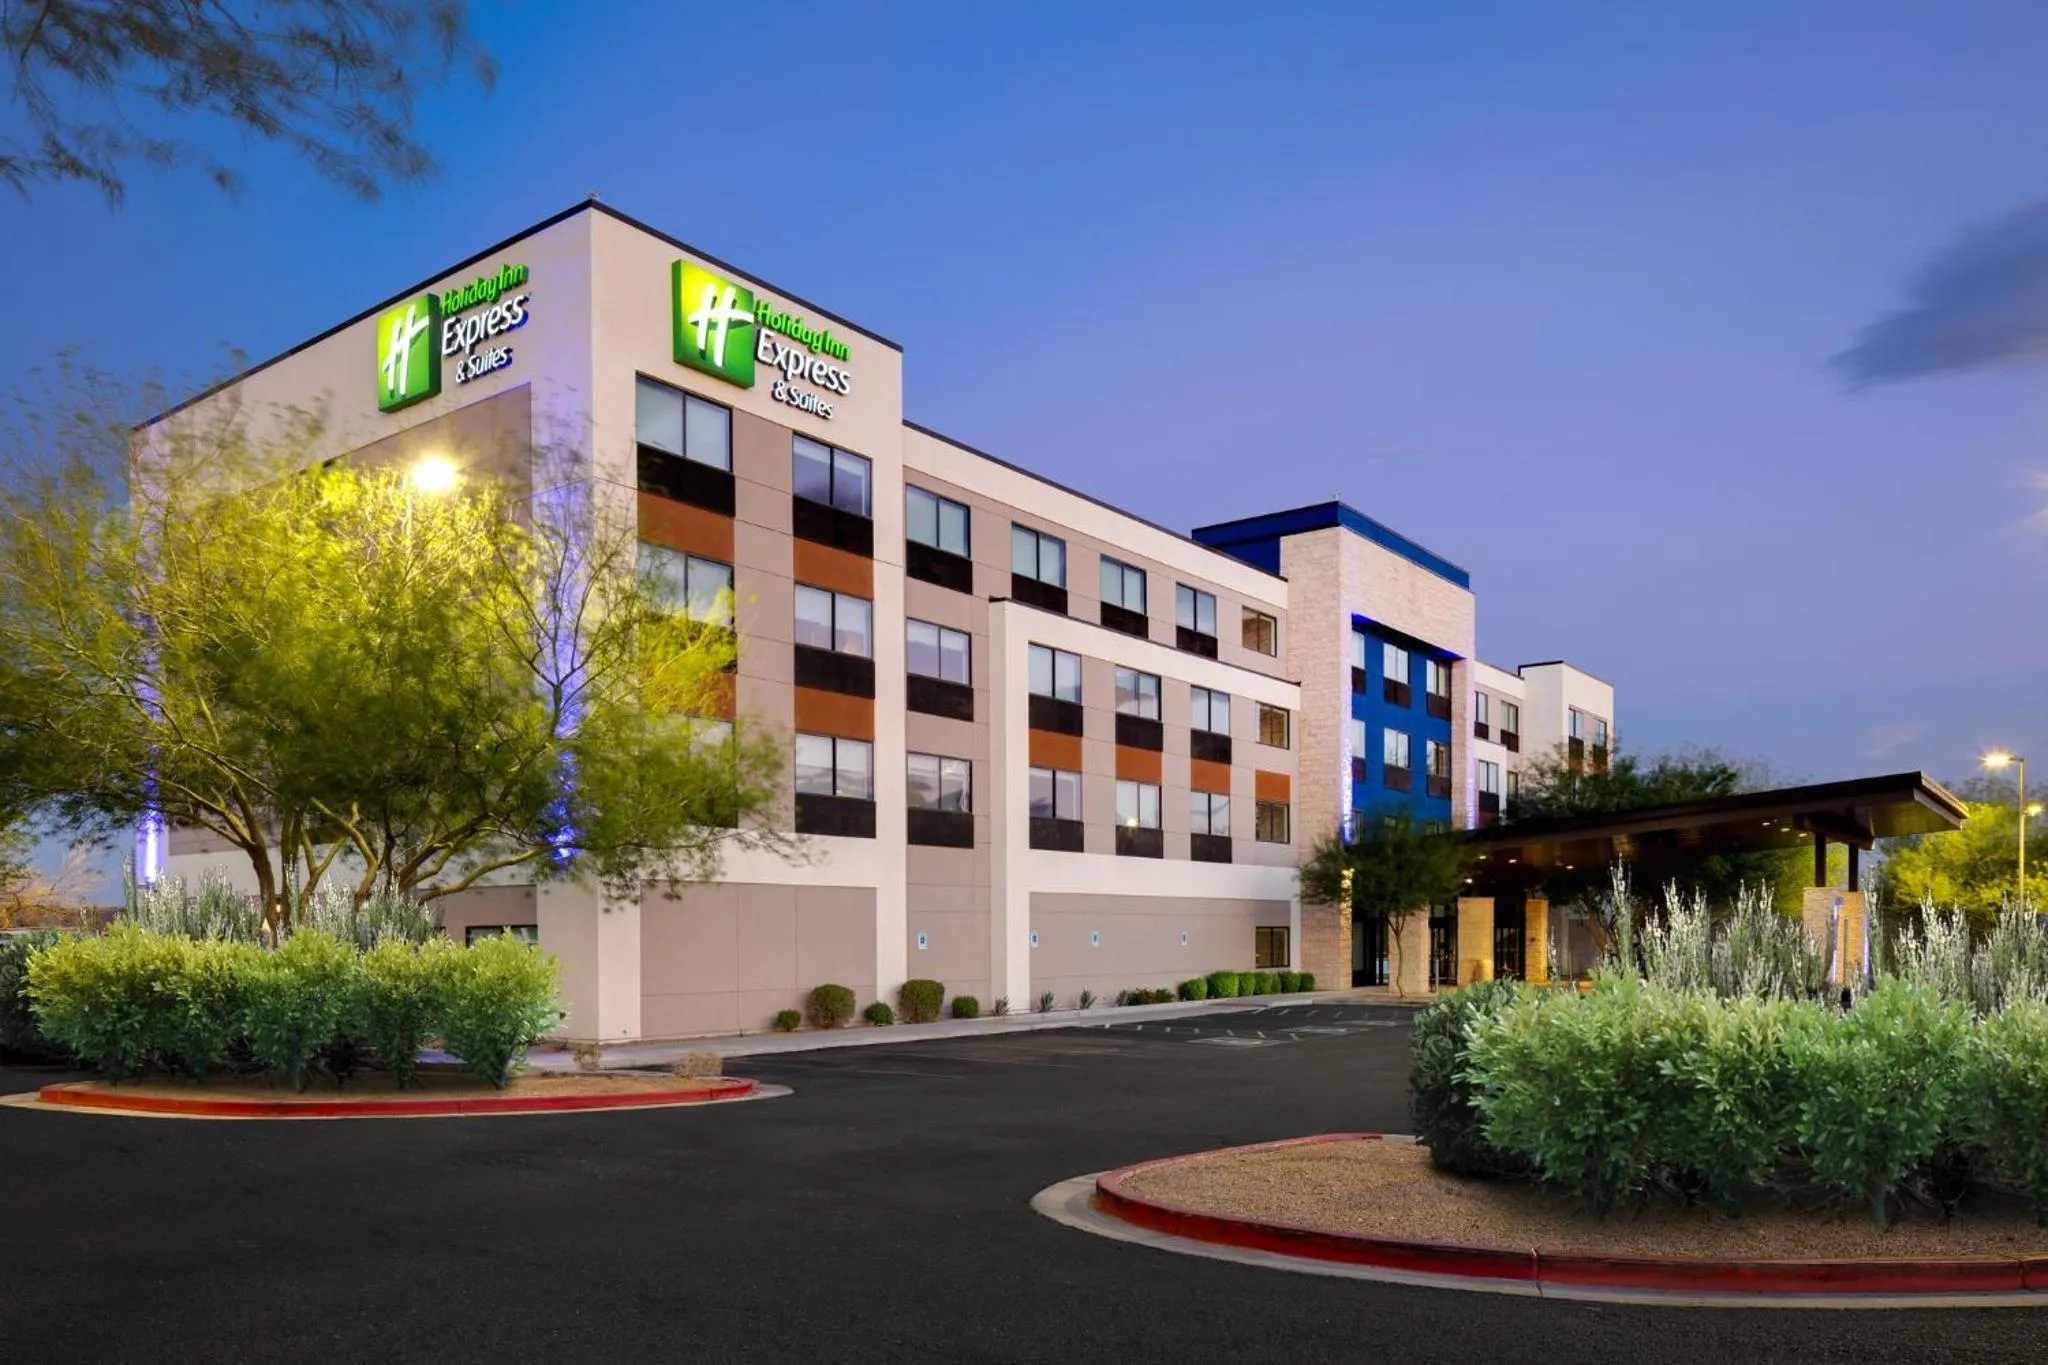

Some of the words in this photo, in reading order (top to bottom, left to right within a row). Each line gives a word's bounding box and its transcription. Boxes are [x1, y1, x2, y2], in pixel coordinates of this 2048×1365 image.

[442, 276, 500, 315] Holiday
[499, 264, 528, 291] Inn
[441, 294, 529, 355] Express
[755, 300, 823, 353] Holiday
[823, 330, 850, 360] Inn
[455, 360, 466, 383] &
[467, 346, 511, 378] Suites
[756, 327, 850, 394] Express
[774, 380, 786, 400] &
[787, 385, 834, 419] Suites
